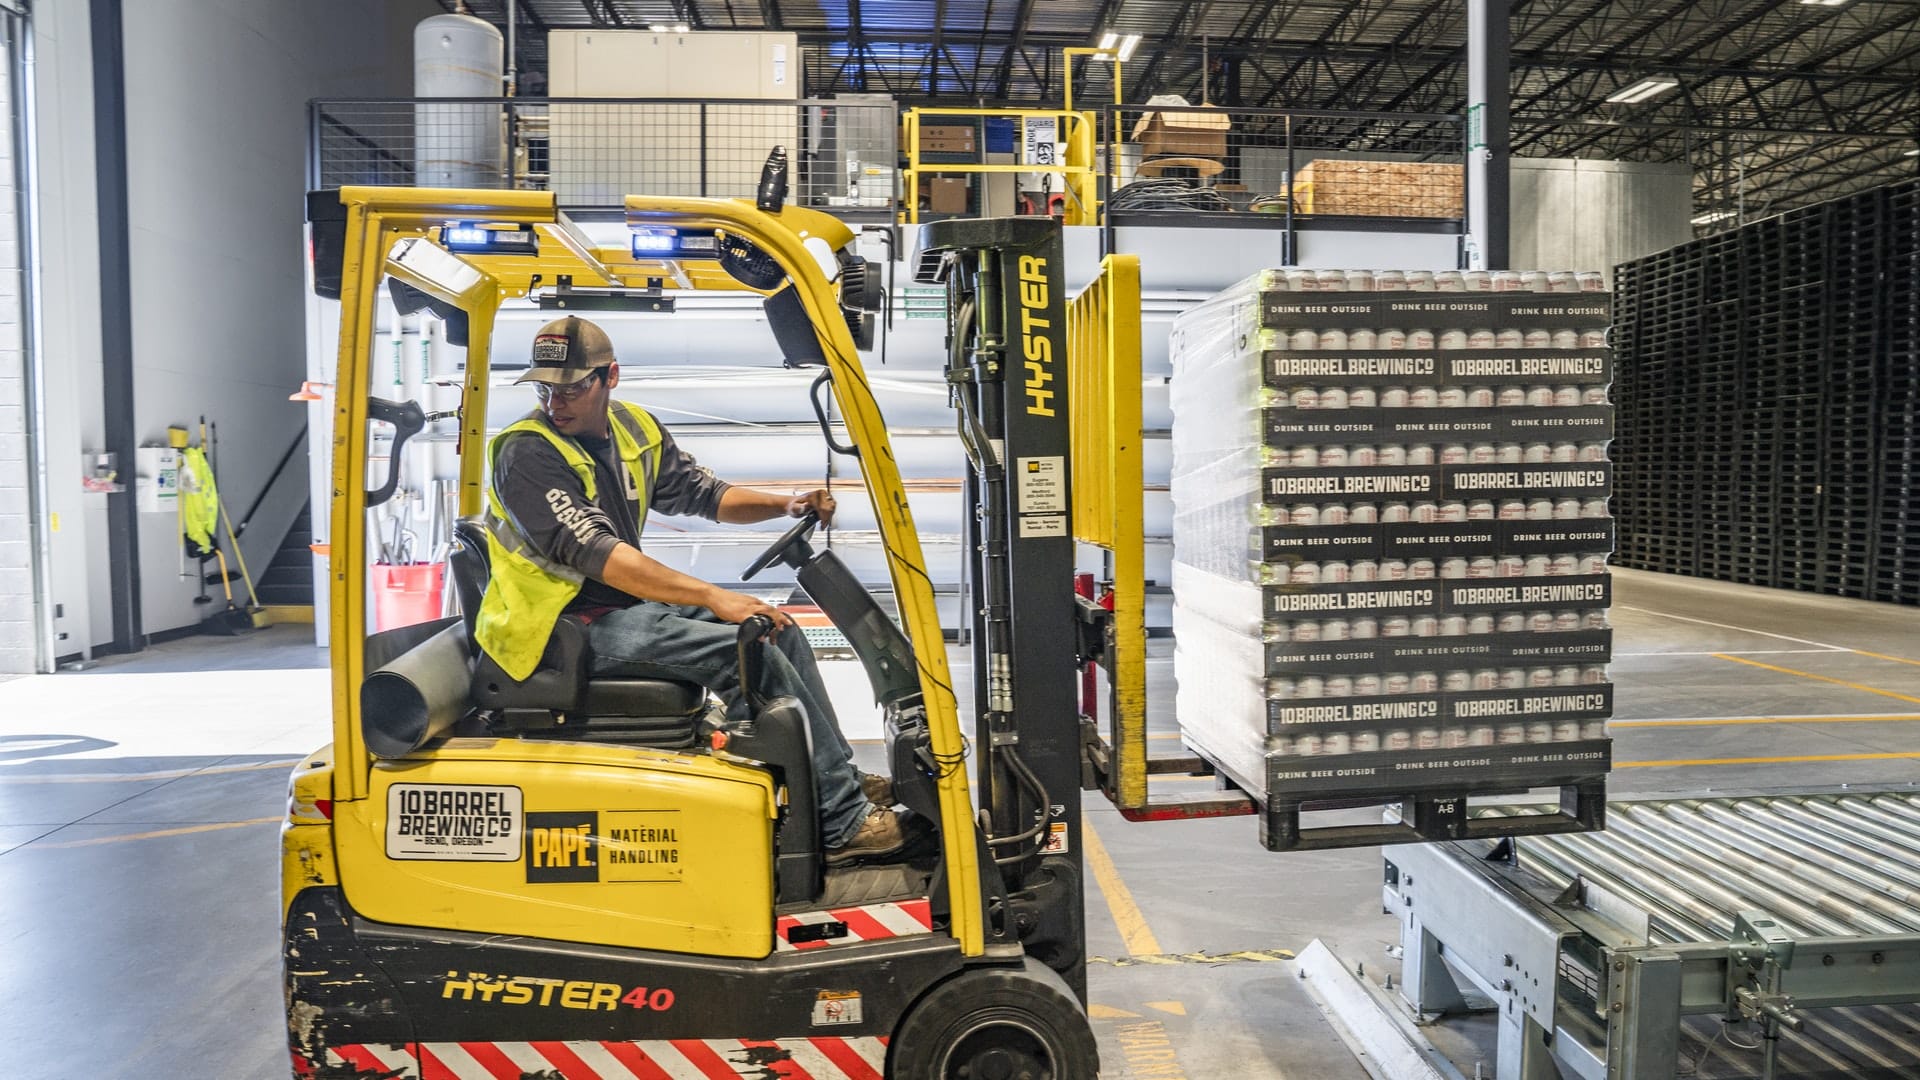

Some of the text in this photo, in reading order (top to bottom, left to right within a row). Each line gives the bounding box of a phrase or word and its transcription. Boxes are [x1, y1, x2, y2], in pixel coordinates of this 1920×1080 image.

[1270, 305, 1371, 313] DRINK BEER OUTSIDE
[1391, 303, 1489, 311] DRINK BEER OUTSIDE
[1511, 307, 1605, 315] DRINK BEER OUTSIDE
[1018, 254, 1055, 417] HYSTER
[1273, 423, 1374, 433] DRINK BEER OUTSIDE
[1395, 422, 1492, 431] DRINK BEER OUTSIDE
[1511, 418, 1604, 427] DRINK BEER OUTSIDE
[1273, 536, 1373, 547] DRINK BEER OUTSIDE
[1395, 534, 1492, 545] DRINK BEER OUTSIDE
[1513, 532, 1606, 542] DRINK BEER OUTSIDE
[1394, 645, 1490, 656] DRINK BEER OUTSIDE
[1512, 644, 1604, 656] DRINK BEER OUTSIDE
[1274, 651, 1374, 664] DRINK BEER OUTSIDE
[1510, 751, 1603, 764] DRINK BEER OUTSIDE
[1395, 758, 1491, 770] DRINK BEER OUTSIDE
[1277, 767, 1376, 780] DRINK BEER OUTSIDE
[1438, 804, 1455, 814] A-B
[398, 815, 485, 837] BREWING
[609, 849, 679, 864] HANDLING
[441, 970, 675, 1012] HYSTER 40
